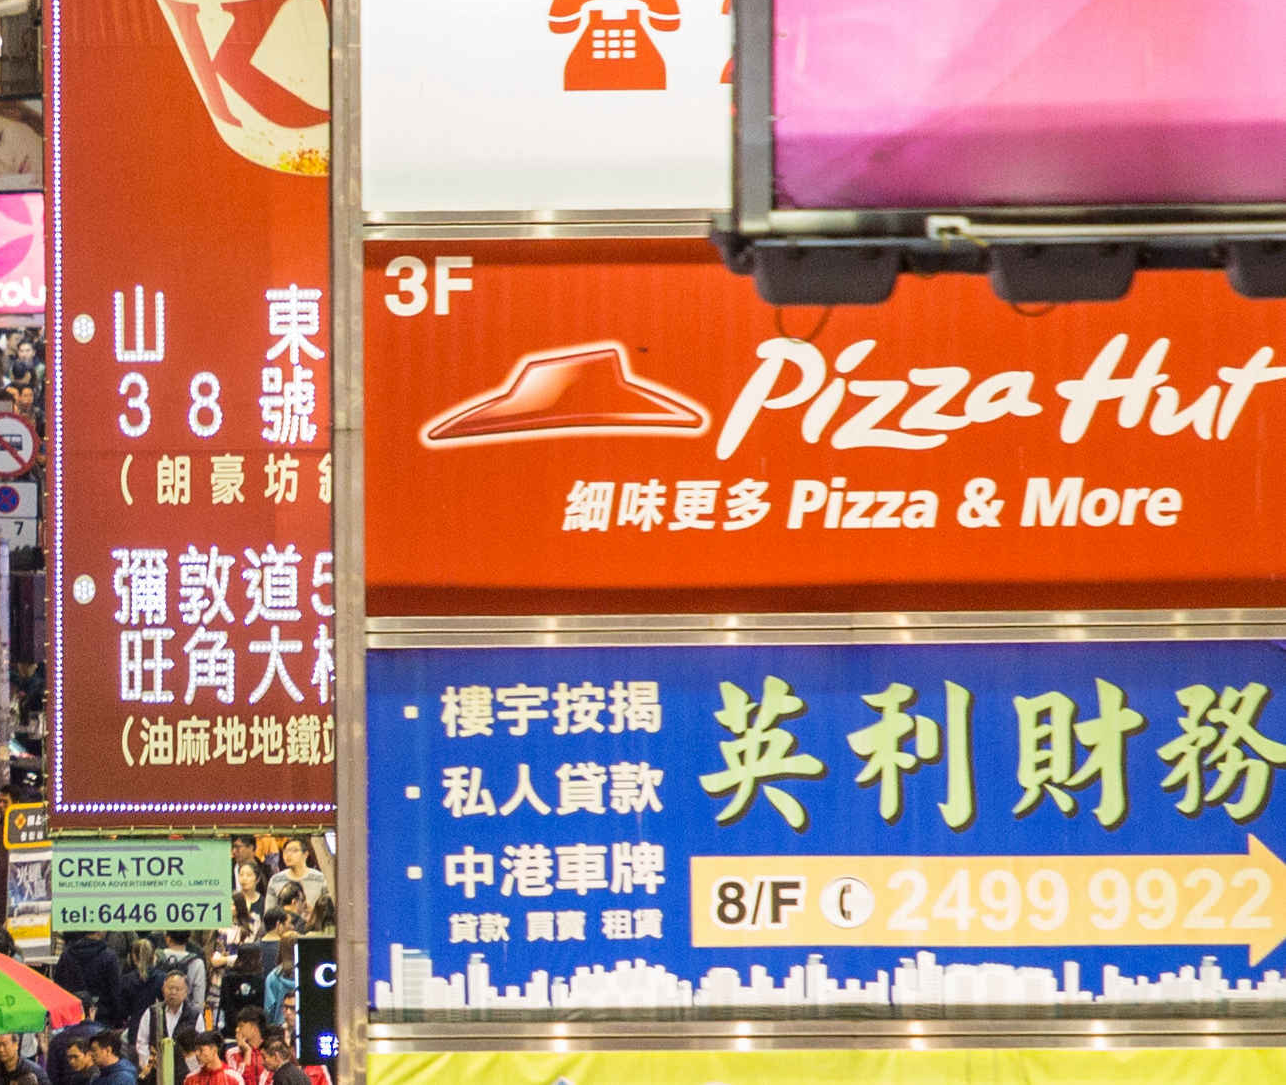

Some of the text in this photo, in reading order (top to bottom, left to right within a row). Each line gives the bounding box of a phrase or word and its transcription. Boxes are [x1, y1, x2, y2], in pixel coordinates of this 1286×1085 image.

[384, 256, 474, 317] 3F
[715, 332, 1286, 461] Pizza Hut
[13, 521, 24, 536] 7
[562, 477, 1183, 533] 細味更多 Pizza & More
[440, 680, 663, 738] 樓宇按揭
[697, 674, 1286, 828] 英利財務
[441, 761, 664, 819] 私人貸款
[58, 880, 107, 889] MULTIMEDIA
[188, 879, 220, 887] LIMITED
[444, 842, 666, 899] 中港車牌
[713, 866, 1273, 932] 8/F 2499 9922
[165, 901, 223, 924] 0671
[449, 911, 511, 944] 貸款
[526, 910, 587, 943] 買賣
